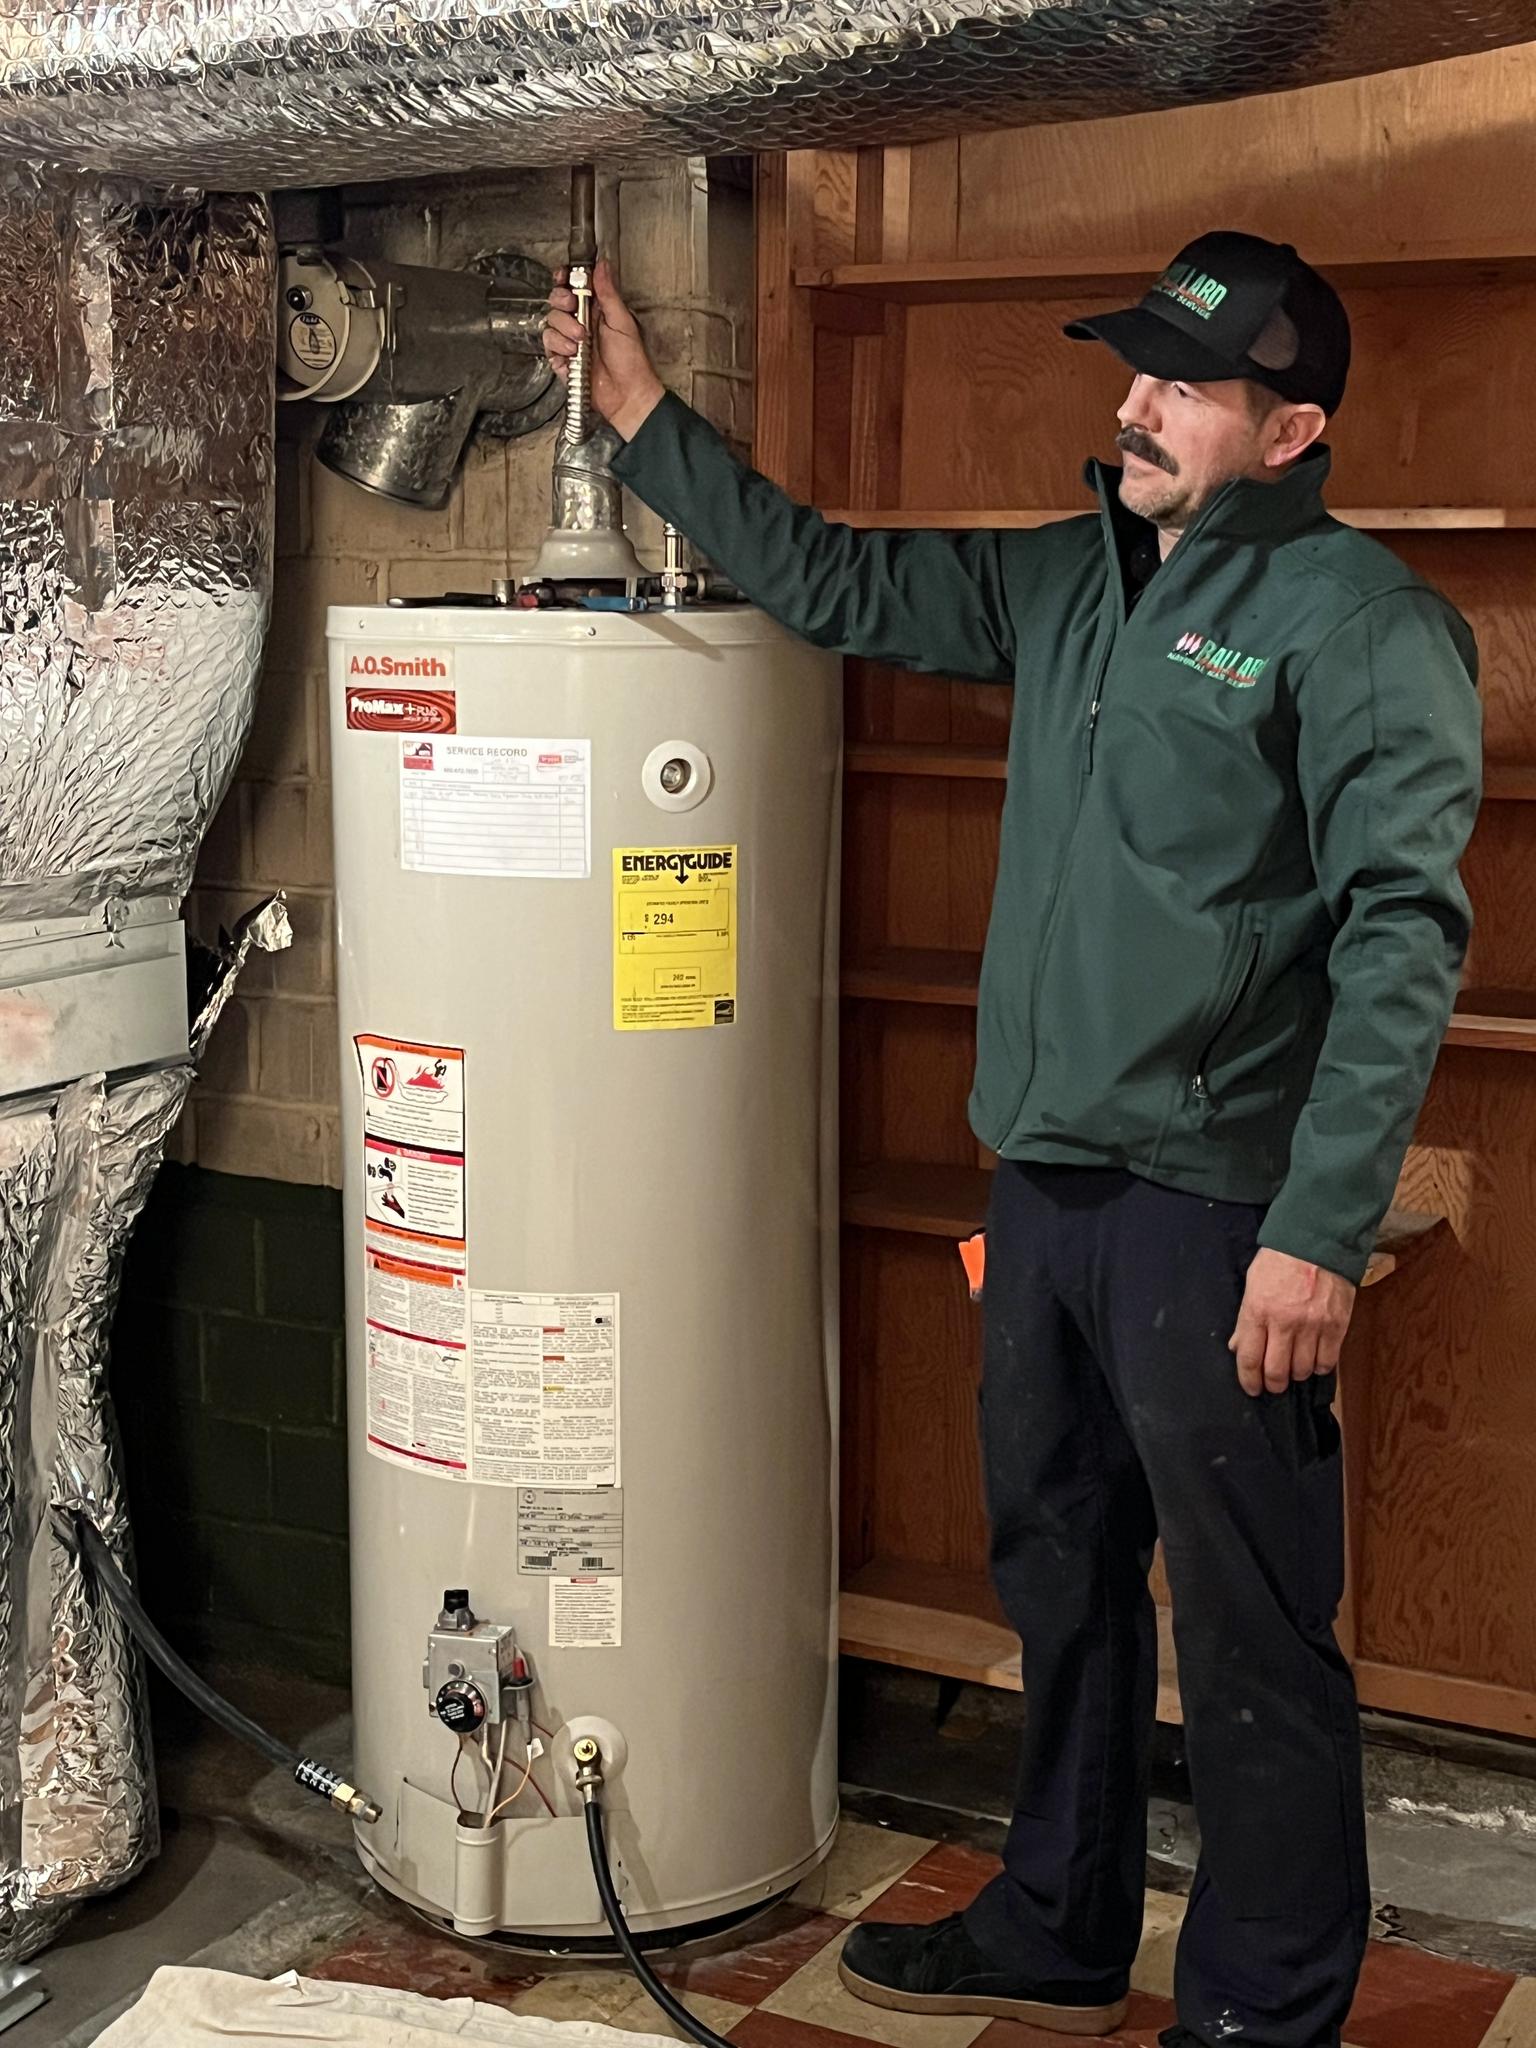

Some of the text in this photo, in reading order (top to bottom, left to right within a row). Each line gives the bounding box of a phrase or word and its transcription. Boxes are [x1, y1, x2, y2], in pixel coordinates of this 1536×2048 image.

[1177, 295, 1213, 320] SERVICE
[350, 655, 446, 677] A.O.Smith
[1195, 639, 1270, 678] BALLAR
[350, 696, 404, 715] ProMax
[446, 746, 528, 757] SERVICE RECORD
[653, 913, 674, 925] 294
